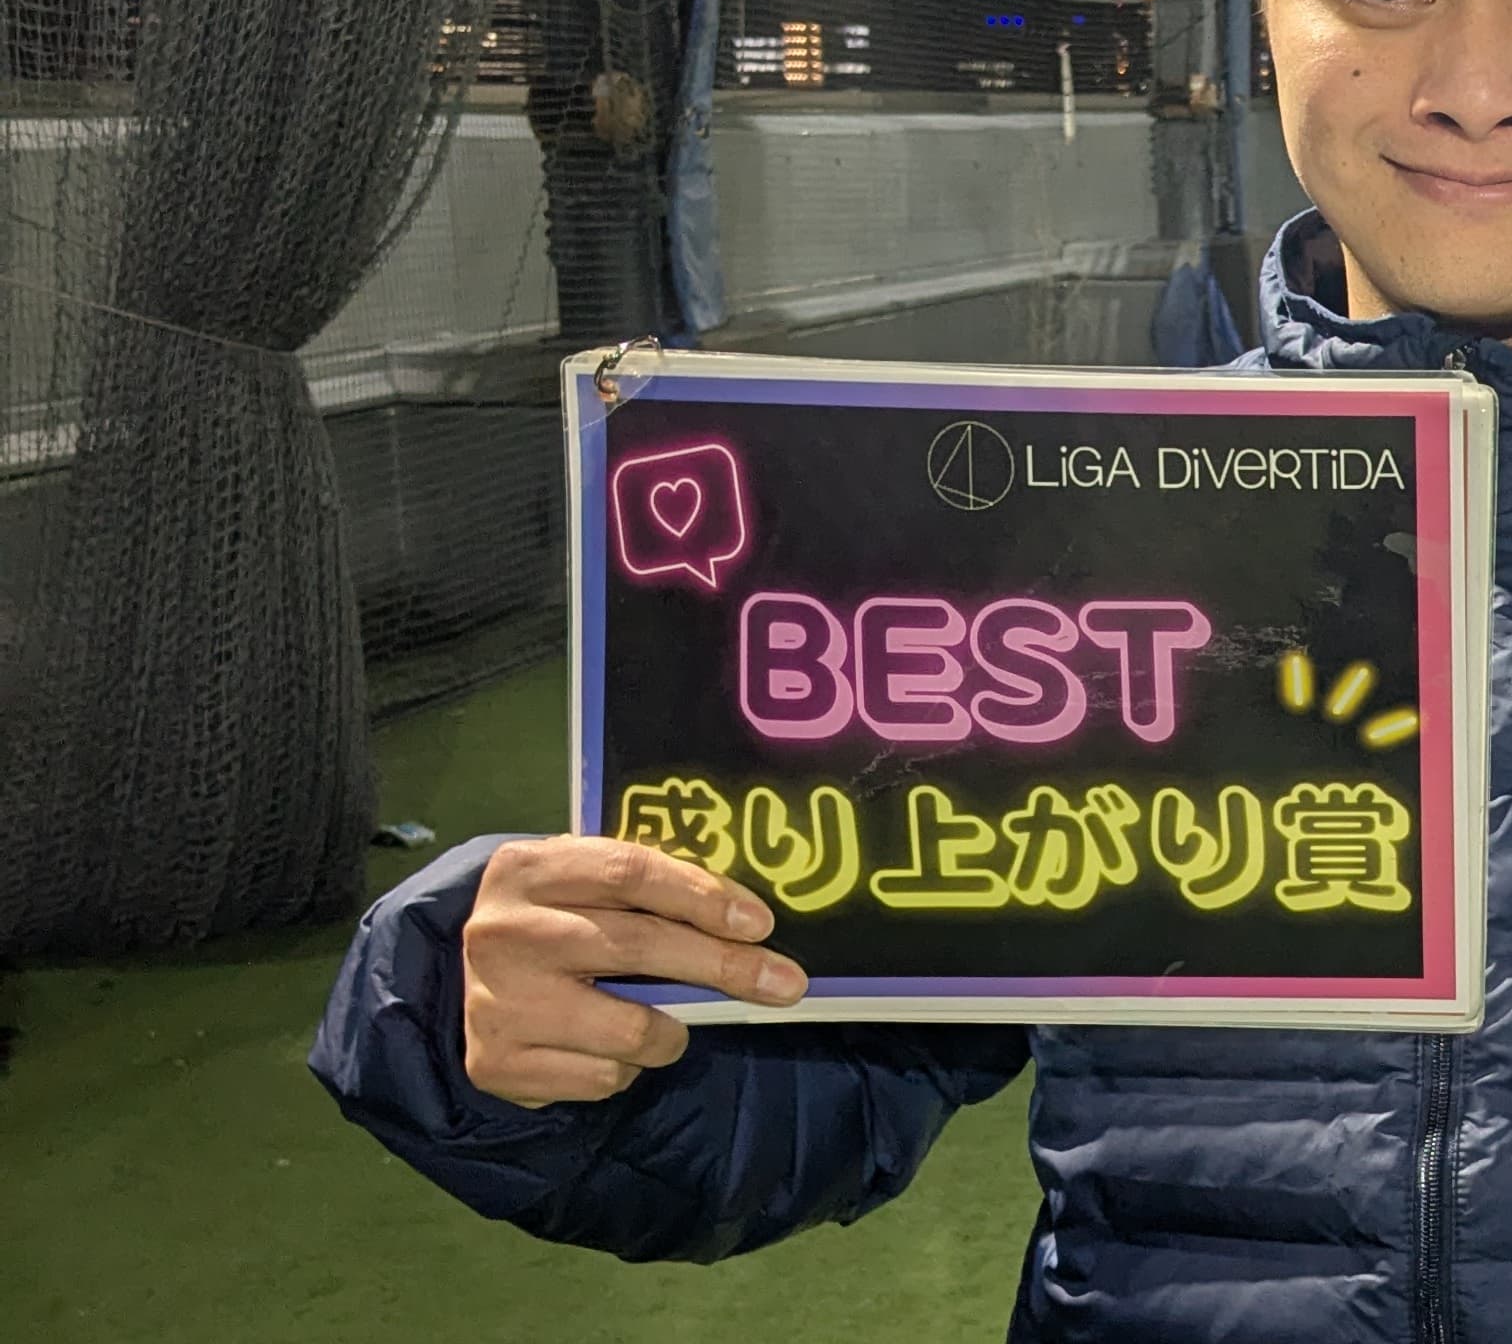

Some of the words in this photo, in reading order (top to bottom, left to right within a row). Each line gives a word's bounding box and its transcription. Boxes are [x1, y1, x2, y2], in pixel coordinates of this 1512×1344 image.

[740, 592, 1211, 743] BEST
[616, 776, 1412, 912] 盛り上がり賞
